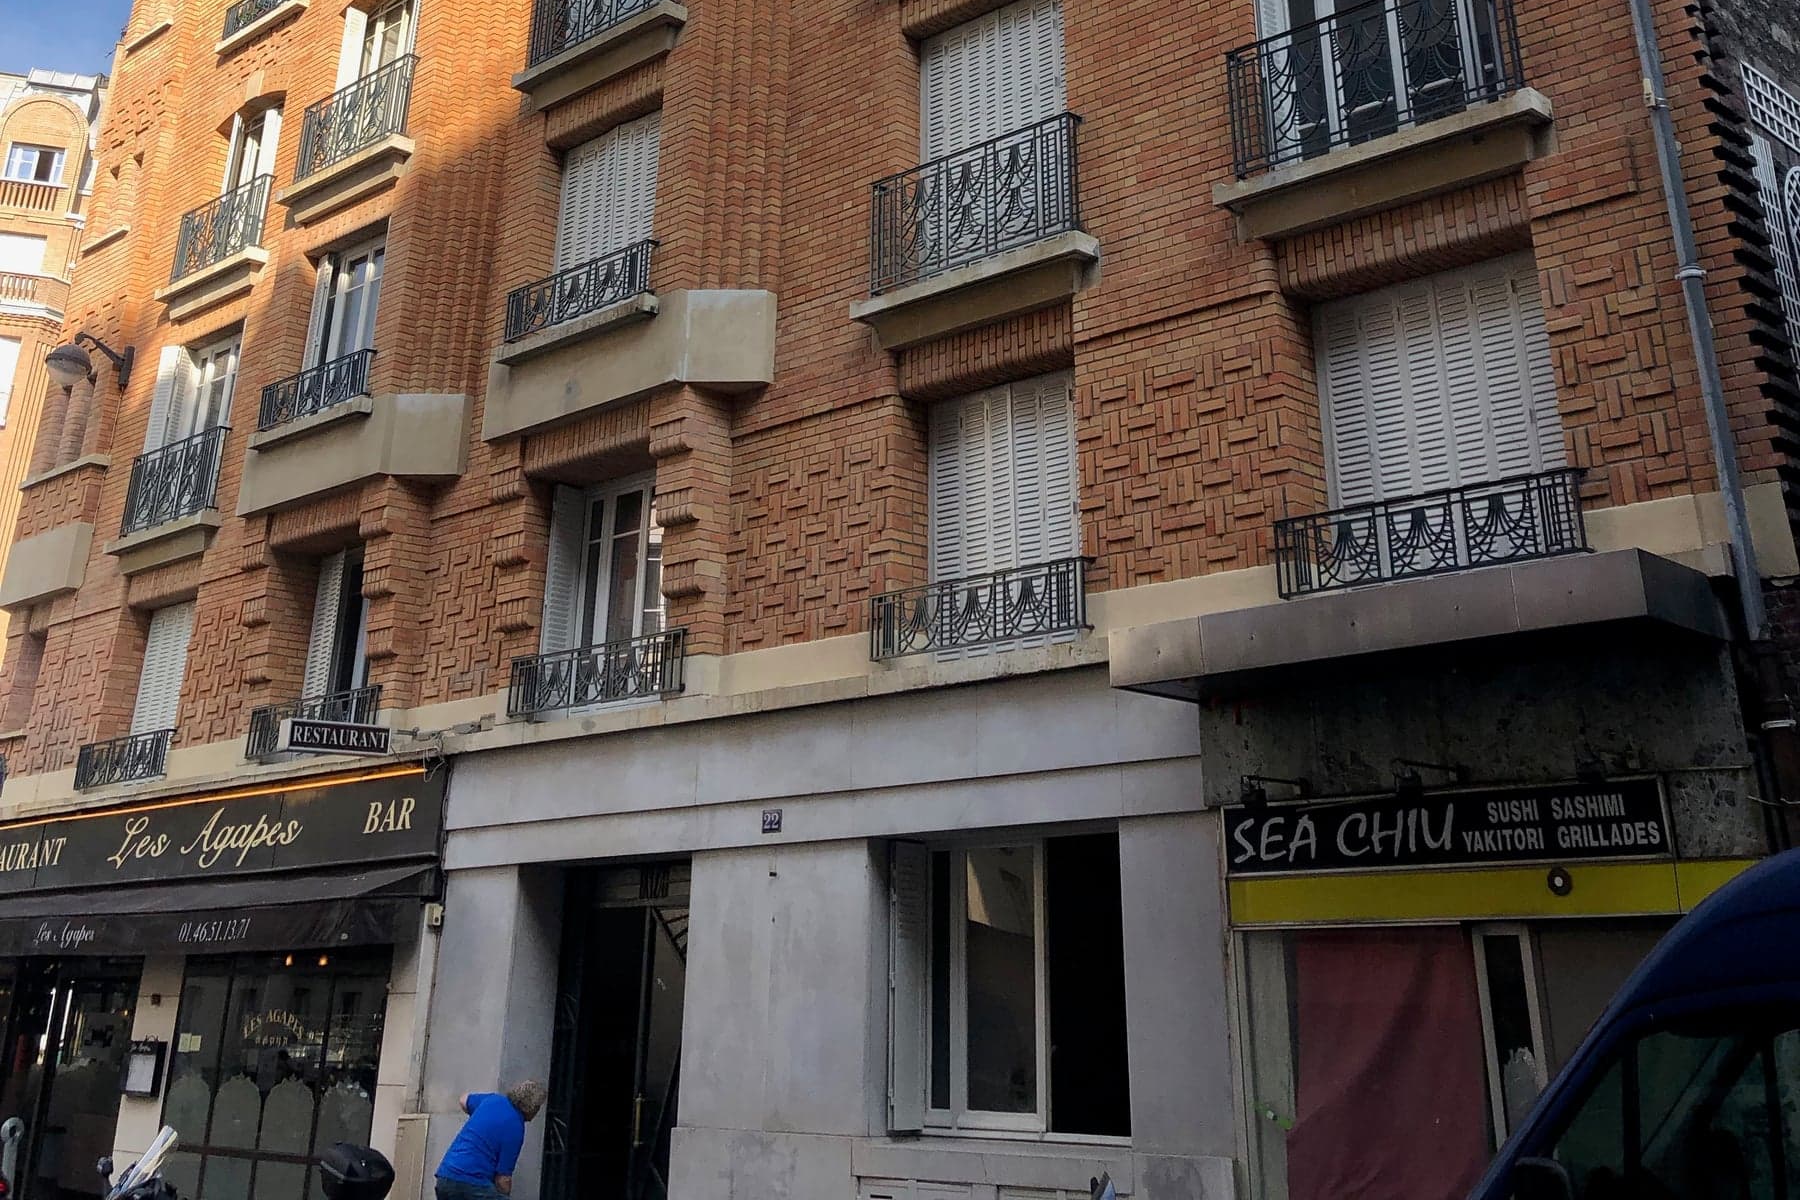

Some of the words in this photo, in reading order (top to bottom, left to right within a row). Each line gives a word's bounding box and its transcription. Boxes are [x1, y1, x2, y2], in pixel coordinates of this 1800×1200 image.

[292, 725, 388, 749] RESTAURANT
[363, 798, 416, 834] BAR
[763, 812, 779, 829] 22
[1487, 799, 1540, 824] SUSHI
[1551, 793, 1626, 820] SASHIMI
[107, 816, 171, 870] Les
[180, 808, 303, 869] Agapes
[1234, 814, 1318, 864] SEA
[1336, 802, 1454, 857] CHIU
[1462, 827, 1545, 853] YAKITORI
[1557, 821, 1661, 849] GRILLADES
[33, 921, 51, 947] Les
[53, 921, 95, 949] Agapes
